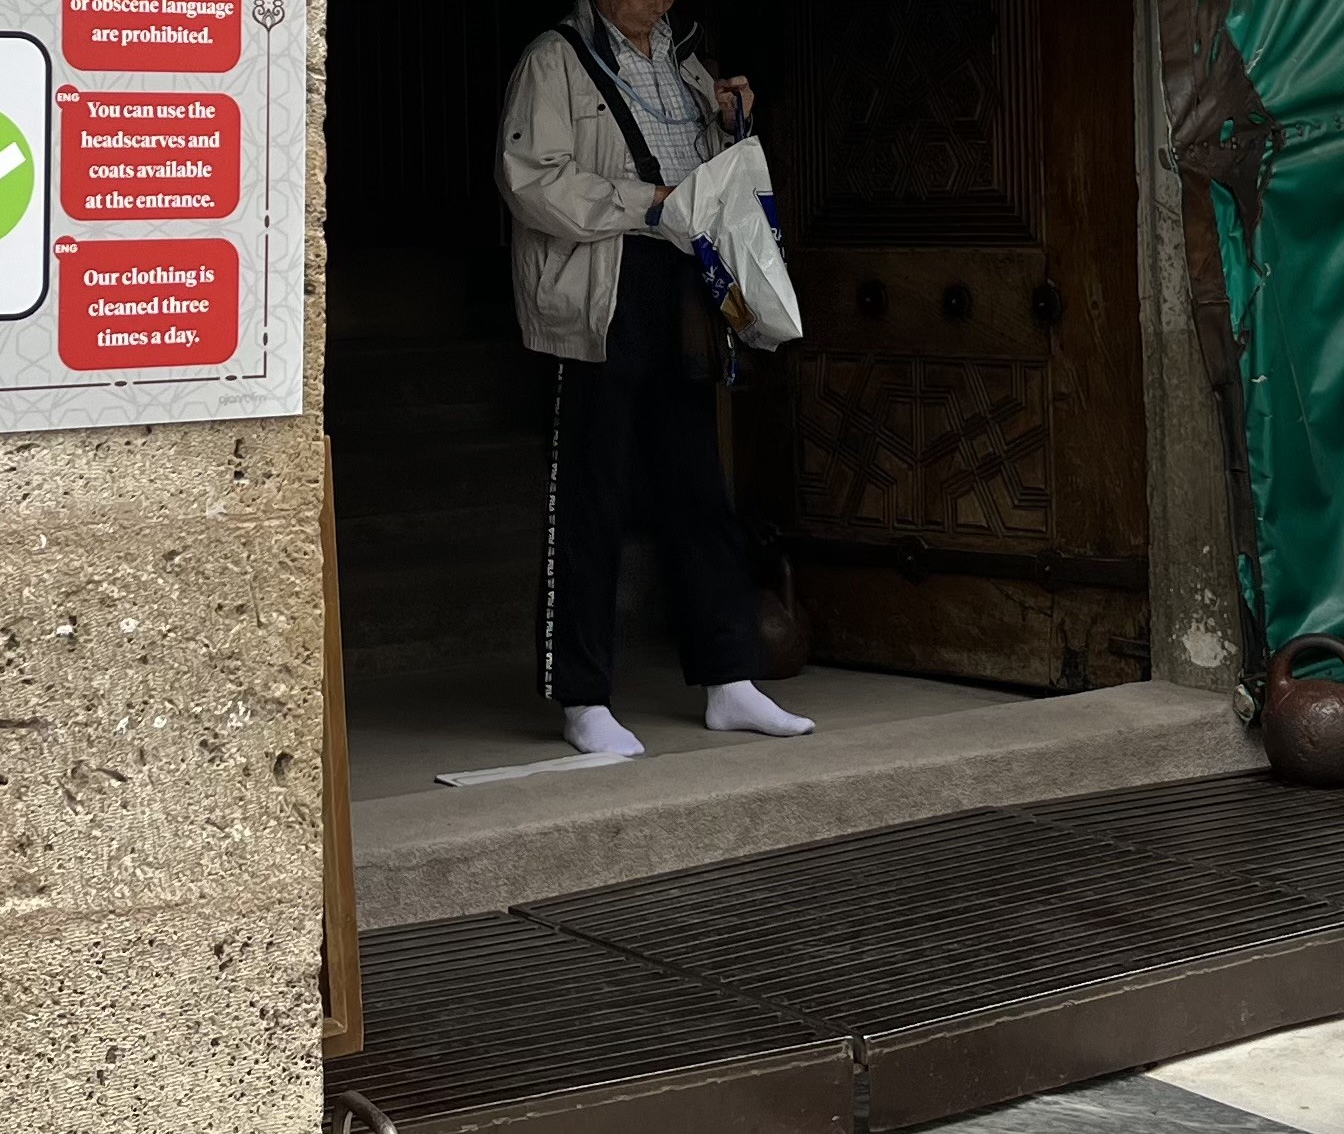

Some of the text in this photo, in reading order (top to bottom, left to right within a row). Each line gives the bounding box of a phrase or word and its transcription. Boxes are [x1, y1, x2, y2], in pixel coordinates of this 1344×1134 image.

[92, 25, 213, 46] are prohibited.
[87, 101, 215, 118] You can use the
[81, 131, 219, 148] headscarves and
[89, 160, 212, 178] coats available
[85, 191, 214, 208] at the entrance.
[83, 265, 214, 287] Our clothing is
[88, 296, 209, 316] cleaned three
[97, 326, 199, 347] times a day.
